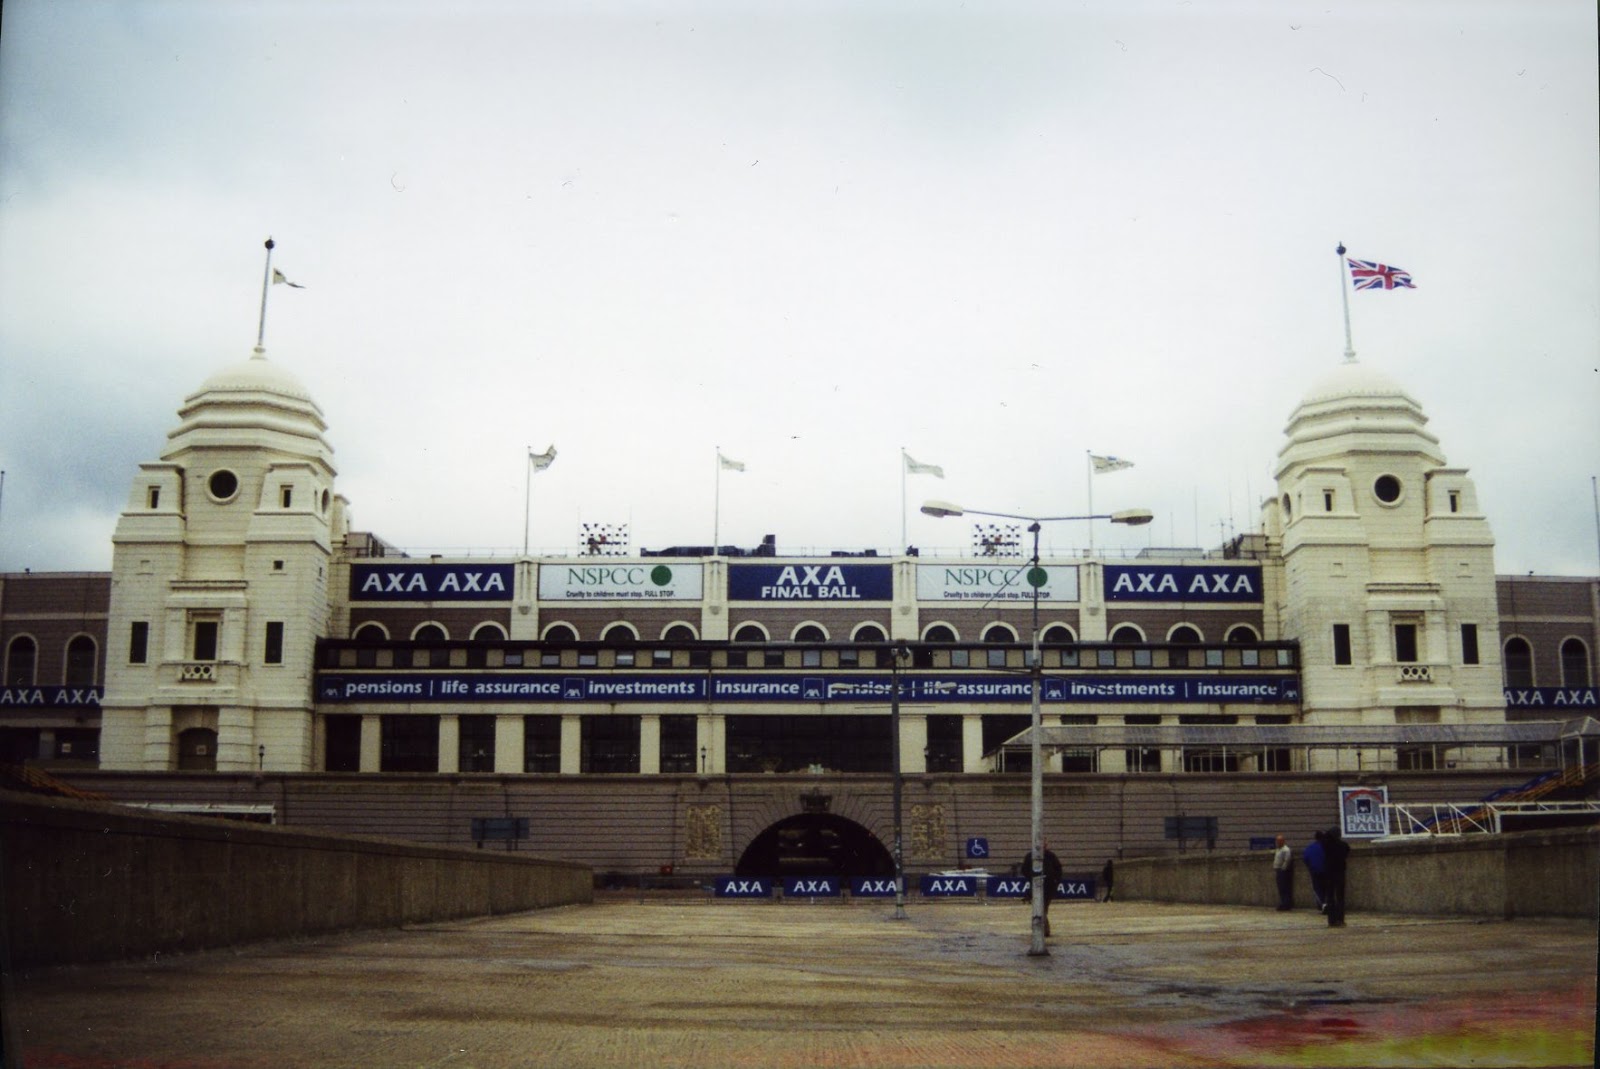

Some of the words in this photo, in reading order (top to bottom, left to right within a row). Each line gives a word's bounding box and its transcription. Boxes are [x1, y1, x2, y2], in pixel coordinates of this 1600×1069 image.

[361, 572, 428, 592] AXA
[438, 572, 506, 592] AXA
[567, 567, 644, 585] NSPCC
[775, 565, 846, 586] AXA
[944, 568, 1020, 586] NSPCC
[1112, 573, 1179, 593] AXA
[1188, 574, 1254, 593] AXA
[566, 590, 585, 598] Cruelty
[593, 590, 615, 598] children
[761, 585, 813, 599] FINAL
[818, 586, 861, 599] BALL
[943, 591, 963, 599] Cruelty
[963, 591, 970, 599] to
[970, 591, 995, 599] children
[345, 681, 422, 697] pensions
[441, 681, 469, 694] life
[475, 683, 560, 694] assurance
[588, 681, 695, 694] investments
[715, 680, 800, 694] insurance
[957, 684, 1043, 695] assuranc
[1071, 682, 1175, 695] investments
[1197, 682, 1278, 695] insurance
[1, 689, 44, 704] AXA
[55, 689, 100, 704] AXA
[1503, 690, 1544, 705] AXA
[1554, 690, 1596, 704] AXA
[1347, 815, 1383, 823] FINAL
[1347, 823, 1385, 832] BALL
[725, 881, 763, 893] AXA
[793, 881, 831, 892] AXA
[860, 880, 897, 892] AXA
[930, 880, 968, 892] AXA
[1057, 883, 1087, 894] AXA
